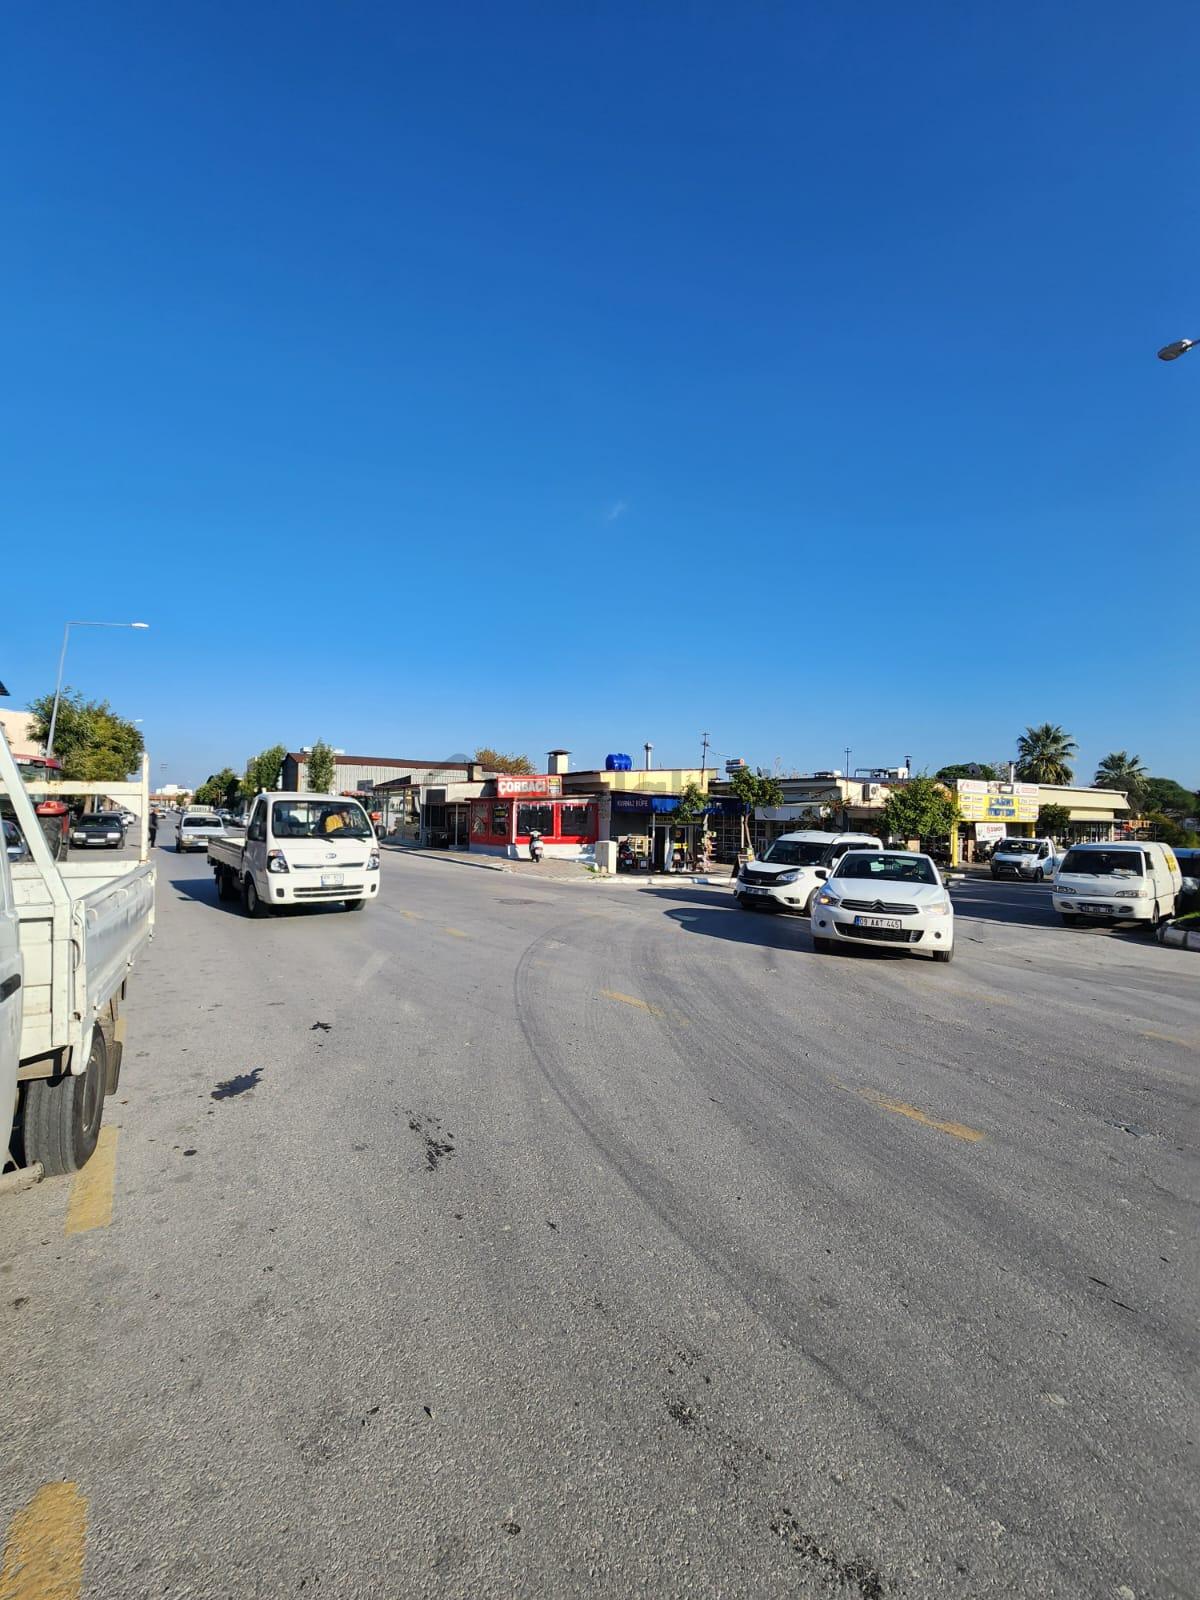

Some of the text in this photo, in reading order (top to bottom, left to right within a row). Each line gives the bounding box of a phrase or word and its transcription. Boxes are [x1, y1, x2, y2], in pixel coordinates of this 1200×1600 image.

[859, 918, 899, 929] 09 AAT 445
